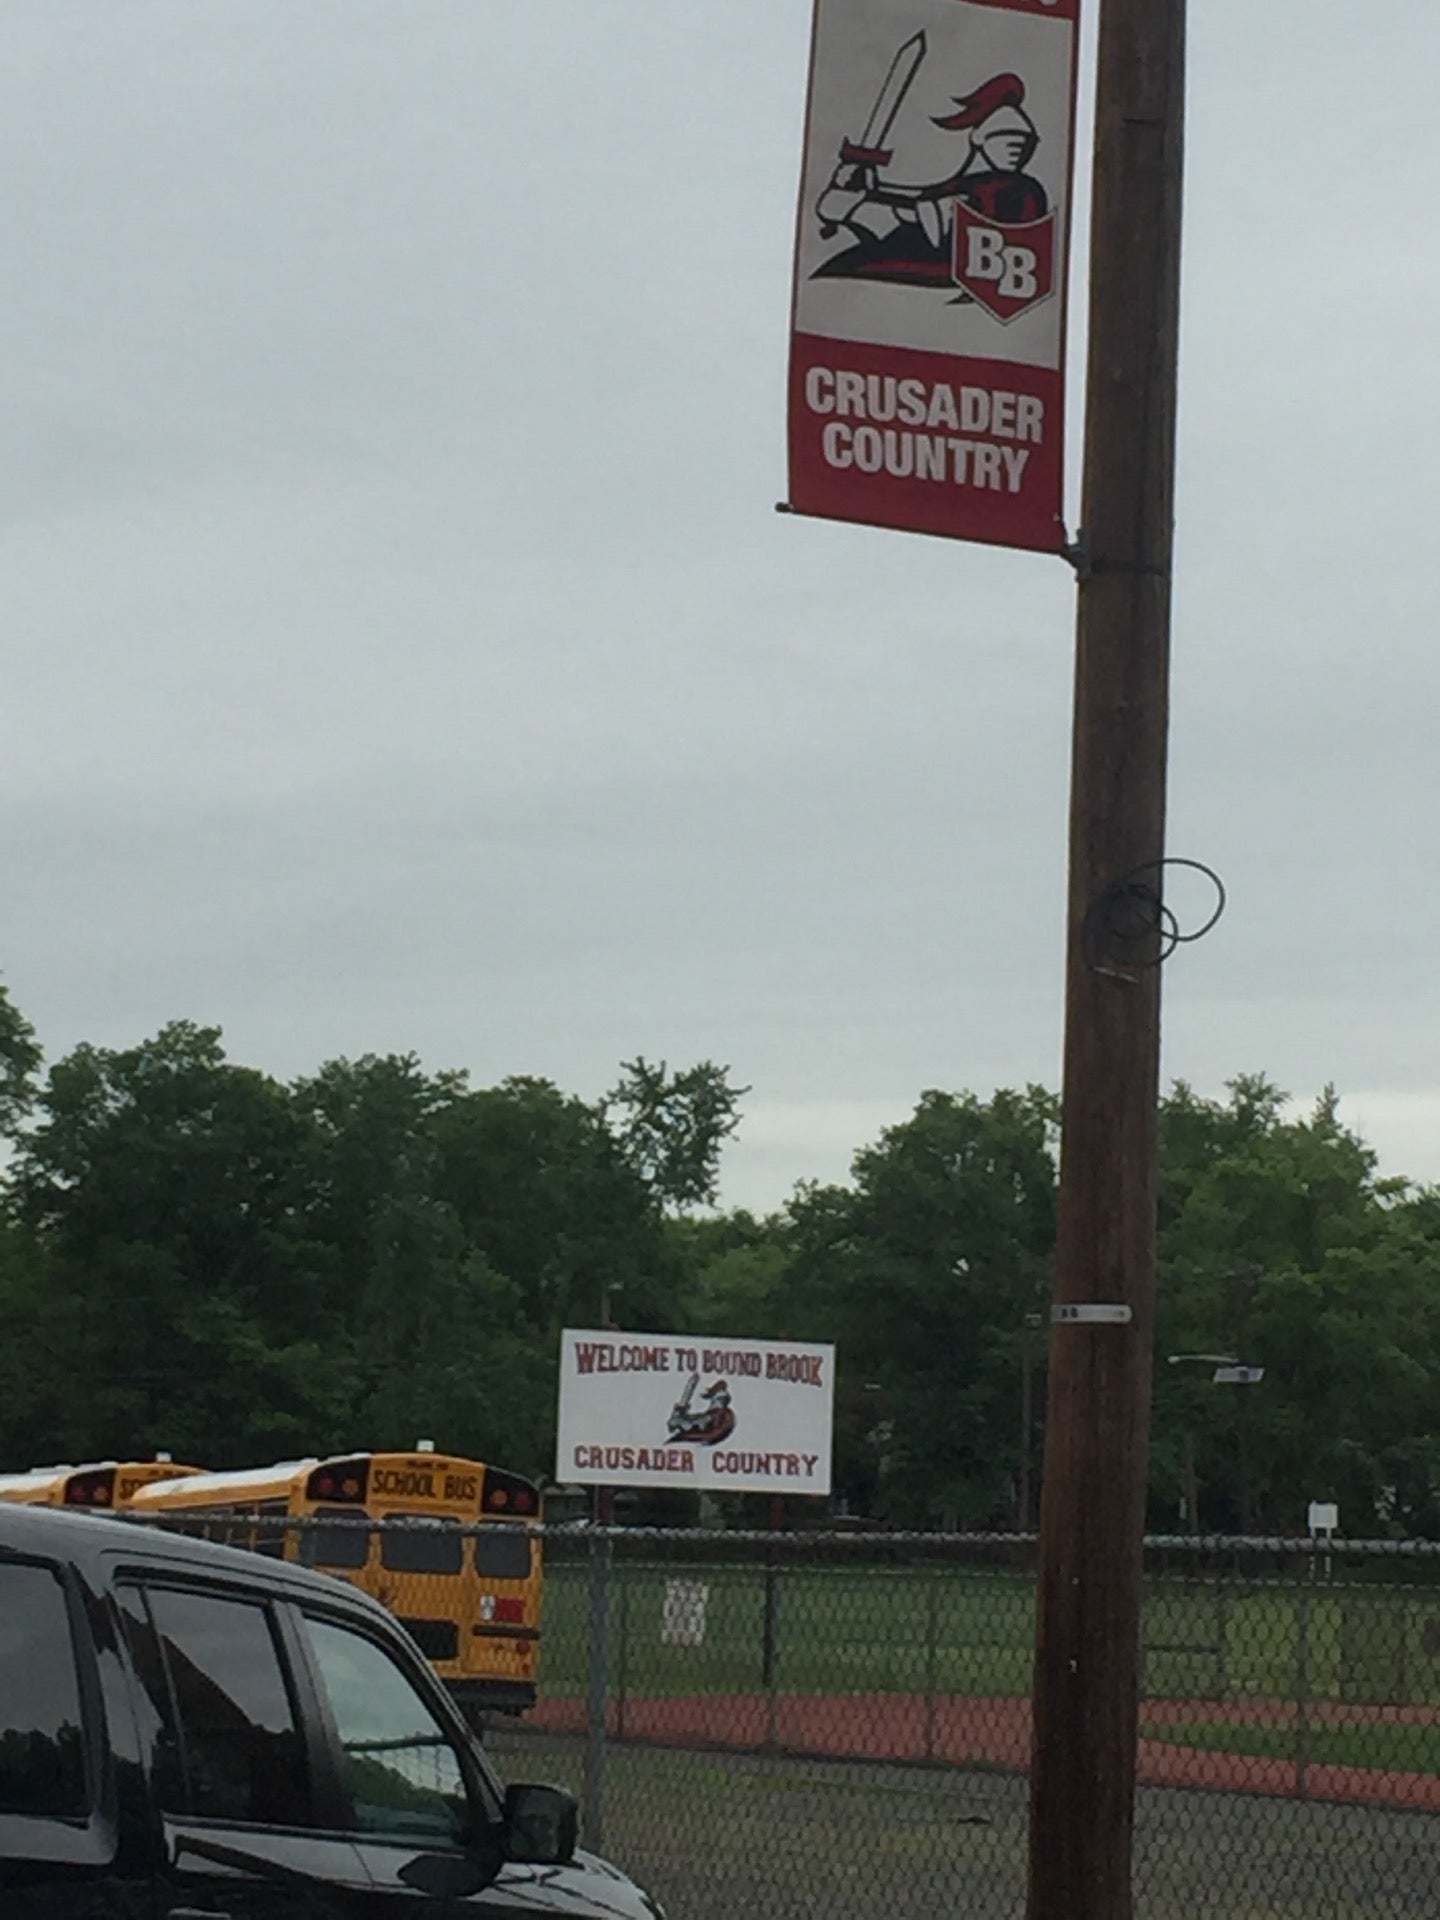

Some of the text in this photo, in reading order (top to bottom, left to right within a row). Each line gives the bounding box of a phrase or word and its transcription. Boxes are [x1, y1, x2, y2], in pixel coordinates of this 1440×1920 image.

[965, 226, 1038, 299] BB
[805, 366, 1044, 444] CRUSADER
[822, 422, 1029, 493] COUNTRY
[574, 1342, 824, 1387] WELCOME TO BOUND BROOK
[372, 1469, 477, 1500] SCHOOL BUS
[573, 1445, 819, 1477] CRUSADER COUNTRY
